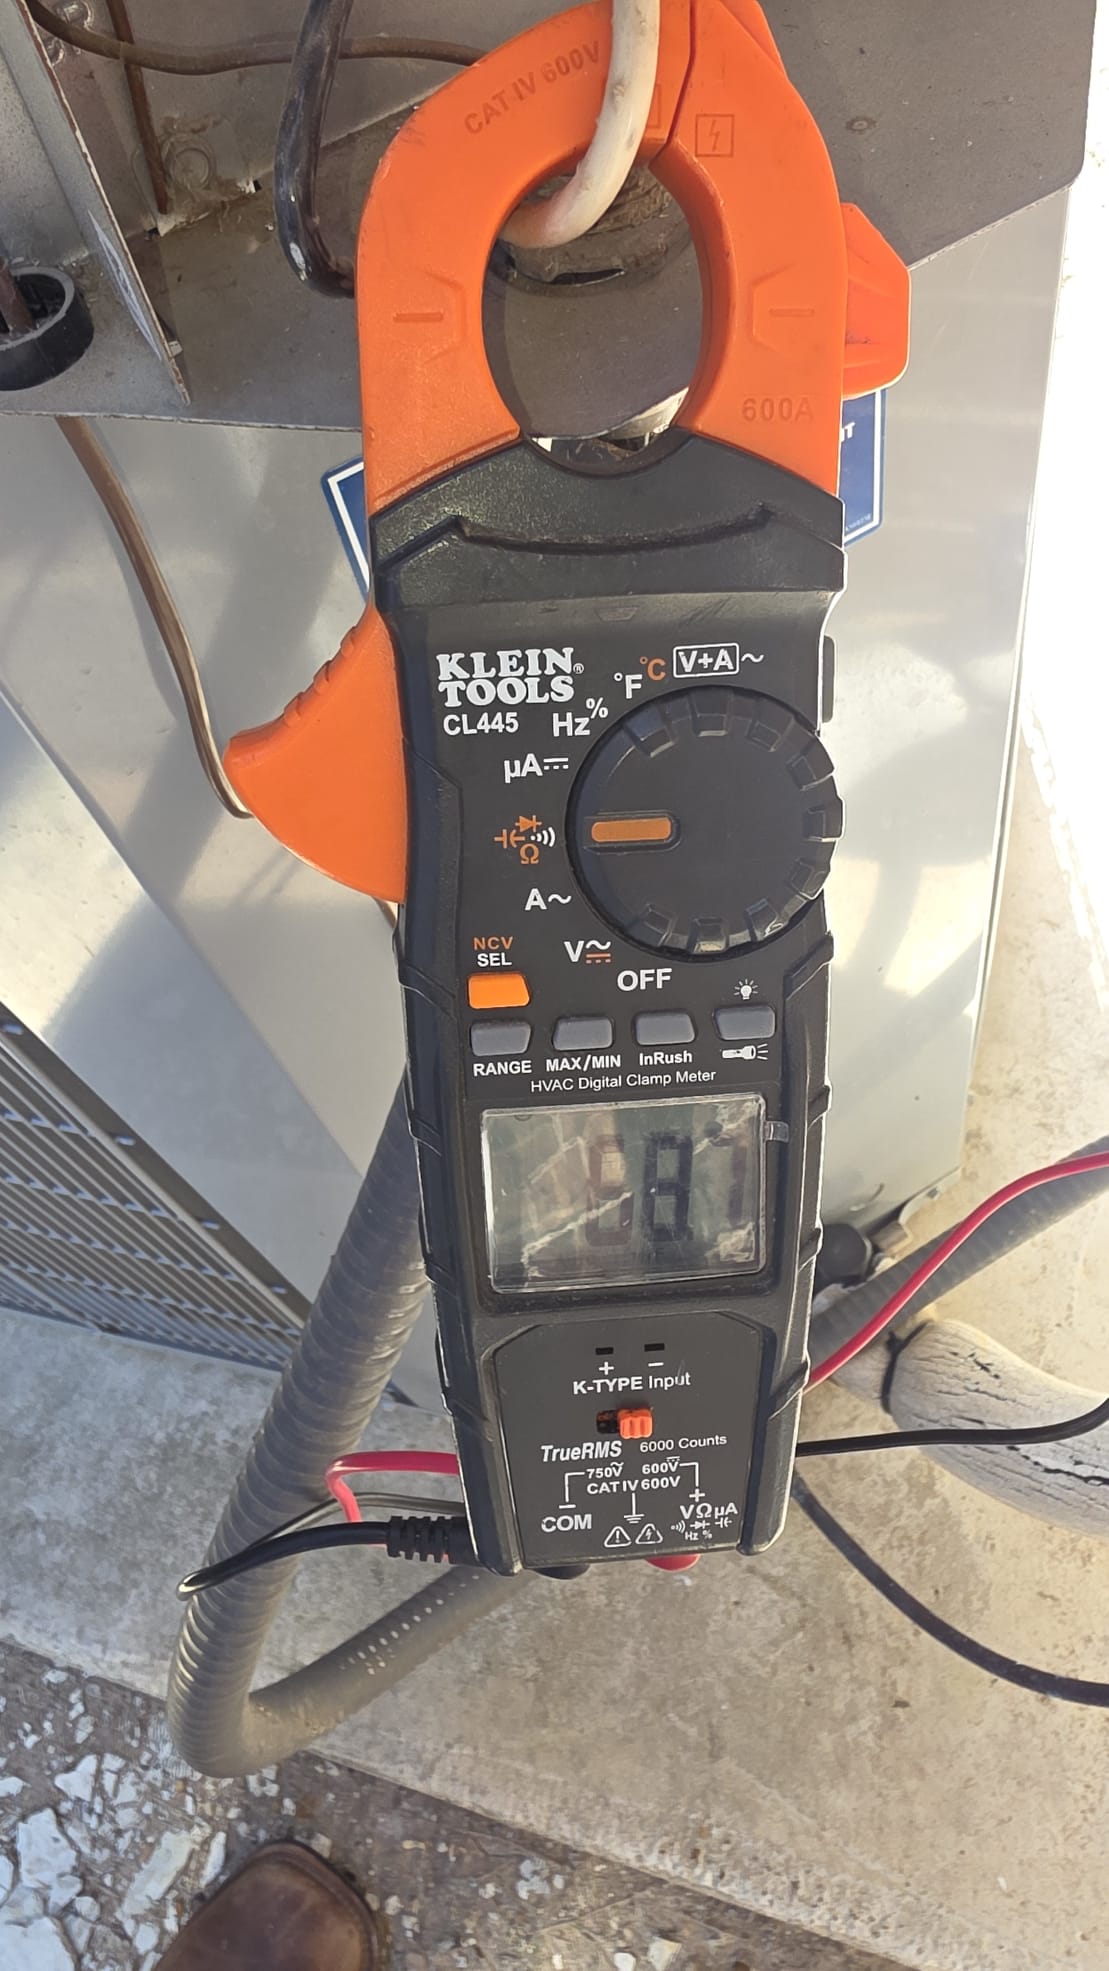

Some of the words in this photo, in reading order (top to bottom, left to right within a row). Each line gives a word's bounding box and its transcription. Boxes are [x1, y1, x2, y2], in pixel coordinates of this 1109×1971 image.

[465, 90, 510, 134] CAT
[512, 71, 536, 101] IV
[541, 40, 599, 83] 600V
[742, 397, 815, 421] 600A
[438, 675, 575, 707] TOOLS
[443, 712, 519, 736] CL445
[473, 936, 514, 951] NCV
[477, 952, 513, 968] SEL
[616, 967, 673, 993] OFF
[473, 1059, 533, 1077] RANGE
[545, 1053, 622, 1073] MAX/MIN
[639, 1050, 693, 1067] InRush
[530, 1076, 574, 1093] HVAC
[578, 1073, 622, 1092] Digital
[626, 1073, 673, 1090] Clamp
[675, 1069, 717, 1084] Meter
[573, 1376, 644, 1395] K-TYPE
[648, 1371, 691, 1391] Input
[541, 1440, 622, 1462] TrueRMS
[639, 1439, 674, 1453] 6000
[678, 1434, 728, 1449] Counts
[586, 1481, 620, 1495] CAT
[622, 1479, 639, 1492] IV
[641, 1475, 680, 1490] 600V
[541, 1513, 592, 1533] COM
[684, 1531, 699, 1541] Hz
